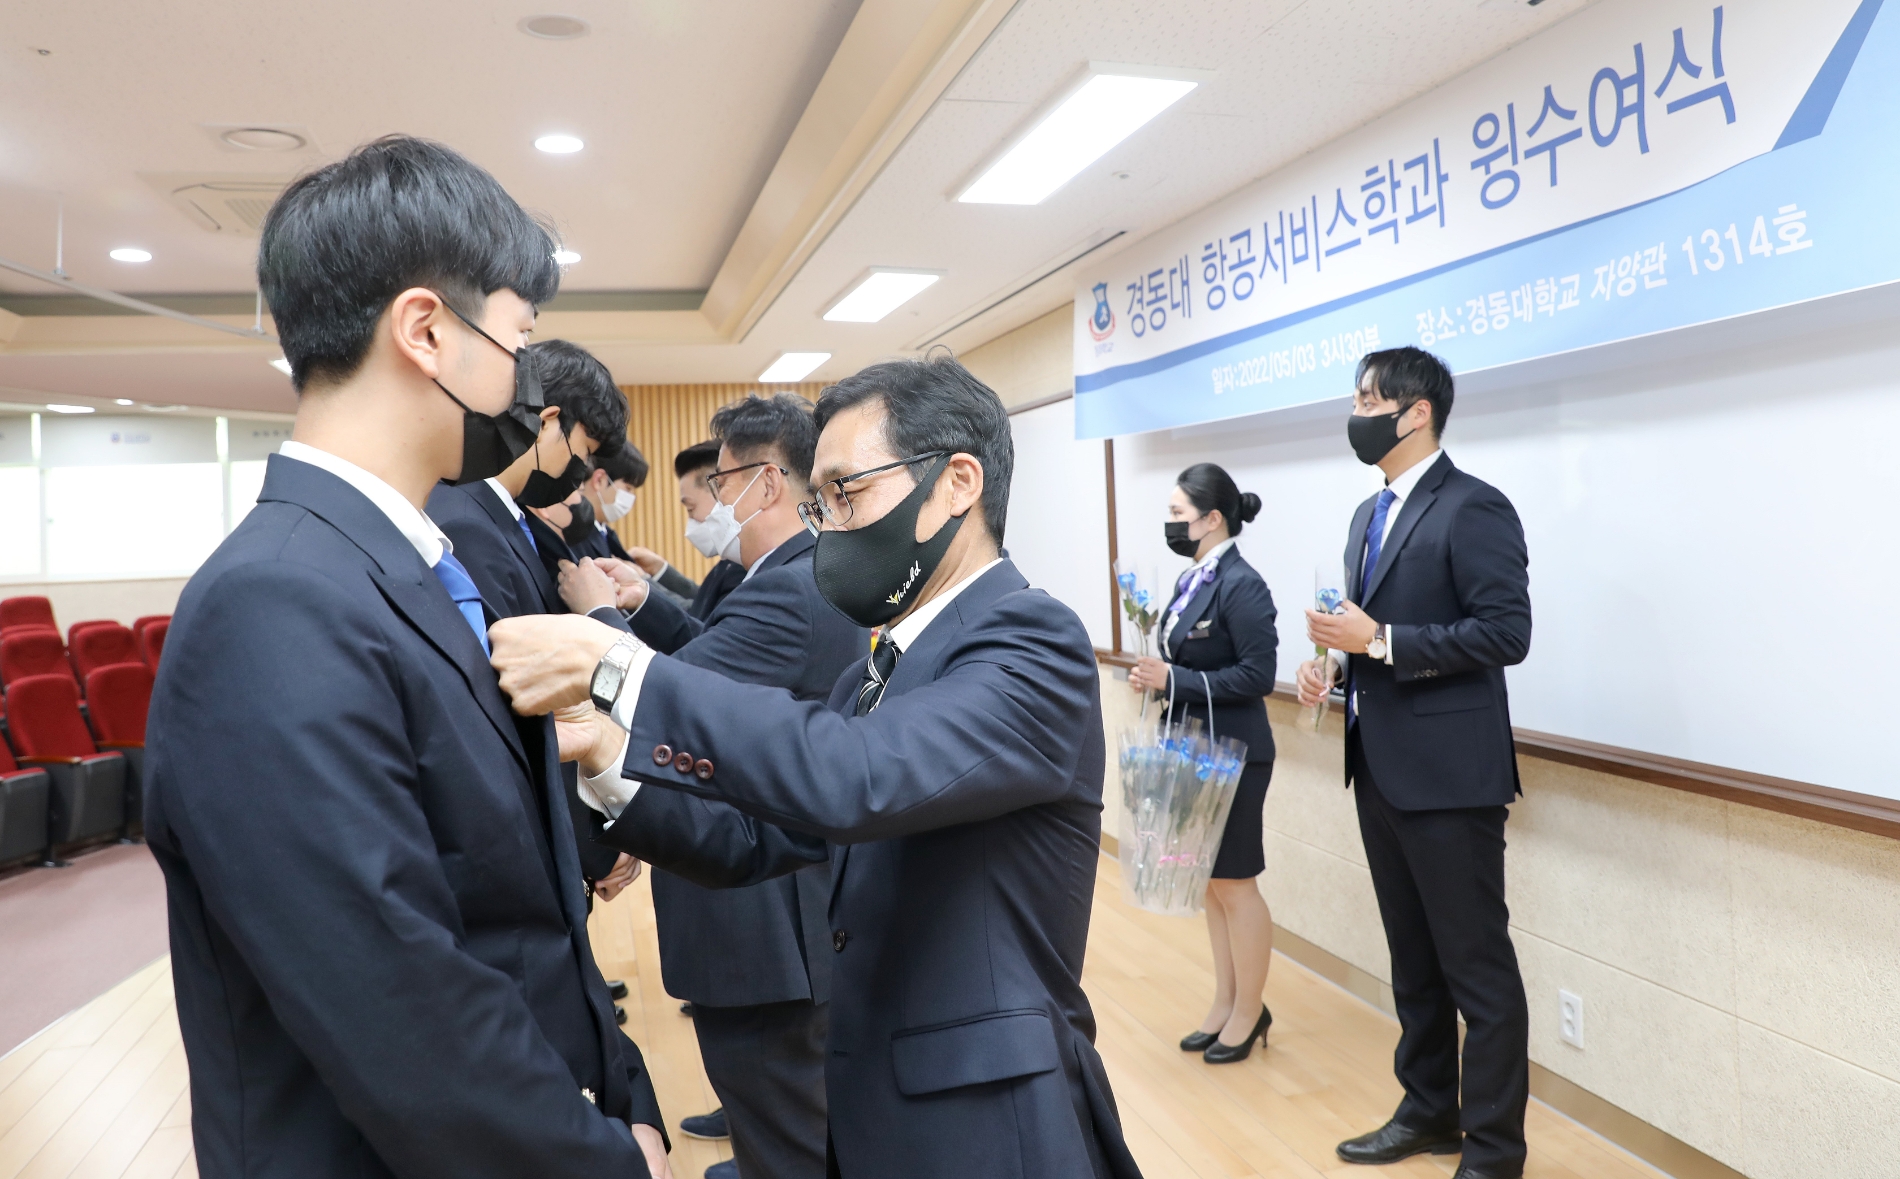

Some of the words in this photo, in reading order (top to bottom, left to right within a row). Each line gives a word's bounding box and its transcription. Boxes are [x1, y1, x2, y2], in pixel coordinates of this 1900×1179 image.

[1126, 254, 1191, 338] 경동대
[1201, 136, 1449, 311] 항공서비스학과
[1469, 4, 1737, 210] 윙수여식
[1415, 273, 1581, 348] 장소:경동대학교
[1590, 241, 1668, 302] 자양관
[1682, 202, 1813, 276] 1314호
